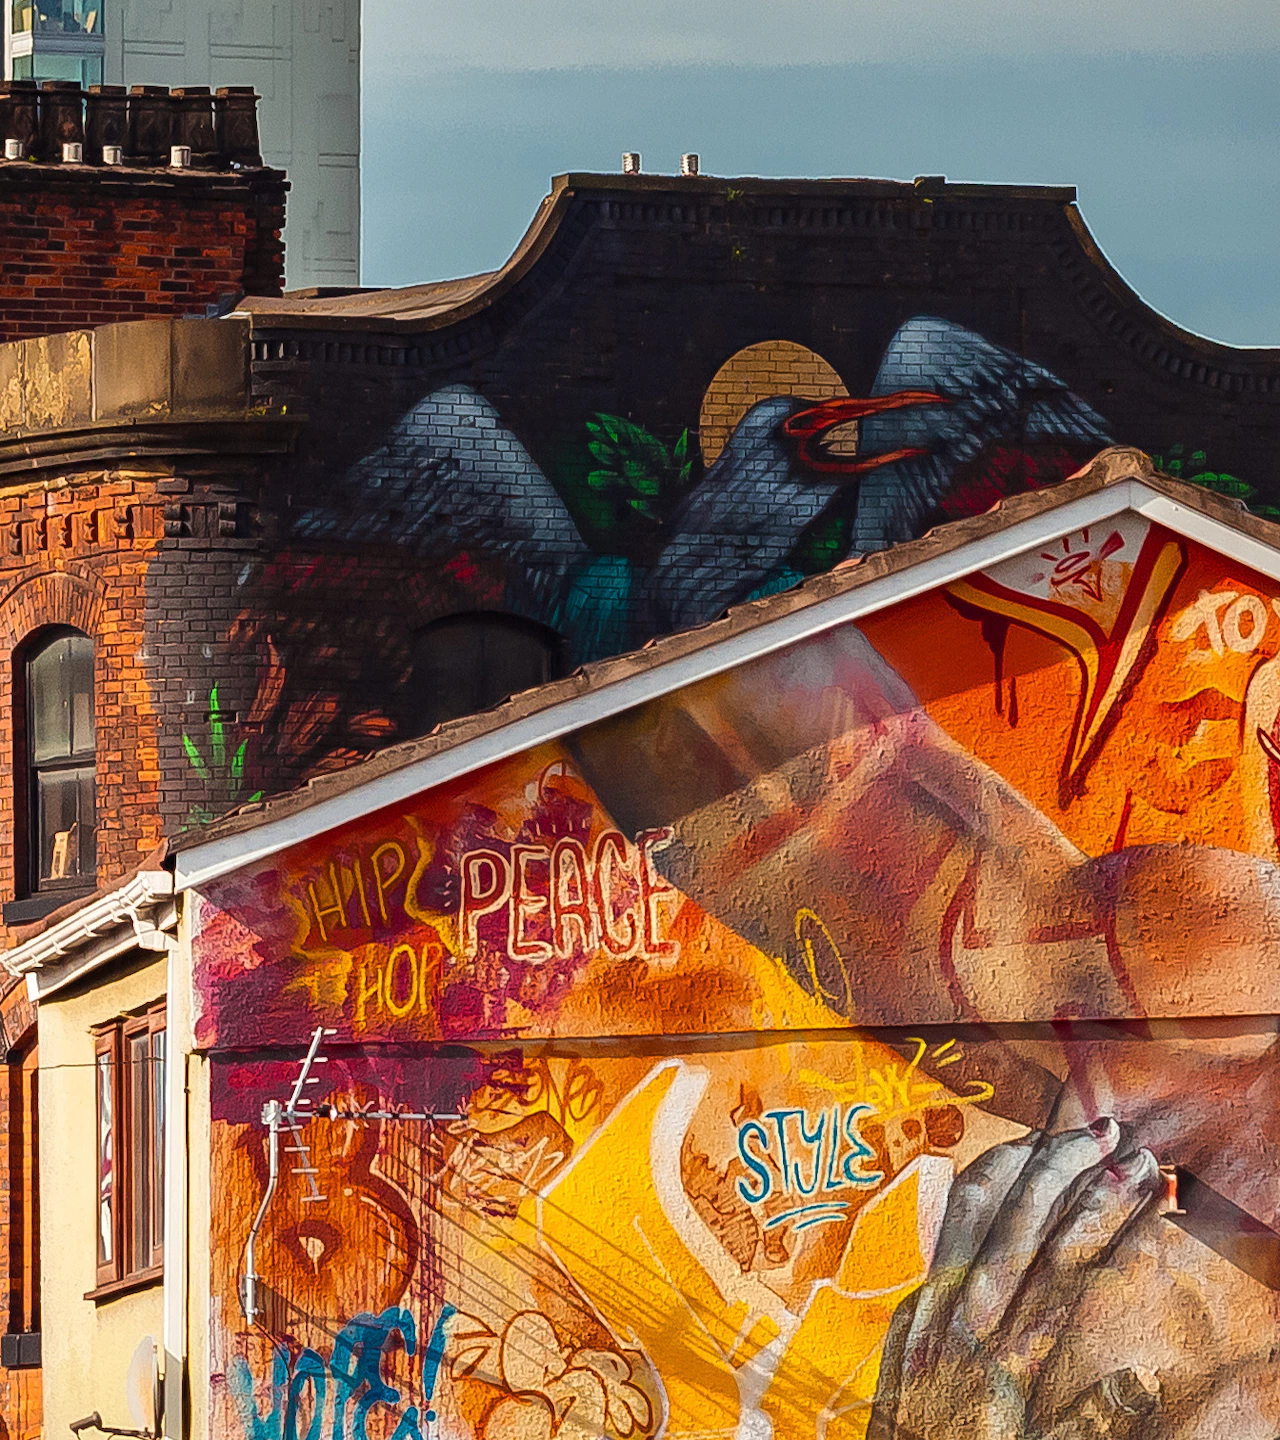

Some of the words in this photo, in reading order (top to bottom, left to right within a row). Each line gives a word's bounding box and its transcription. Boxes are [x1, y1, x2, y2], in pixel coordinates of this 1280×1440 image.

[1171, 589, 1280, 658] TO
[309, 842, 405, 942] HIP
[458, 826, 681, 968] PEACE
[356, 943, 442, 1020] HOP
[738, 1102, 884, 1204] STYLE
